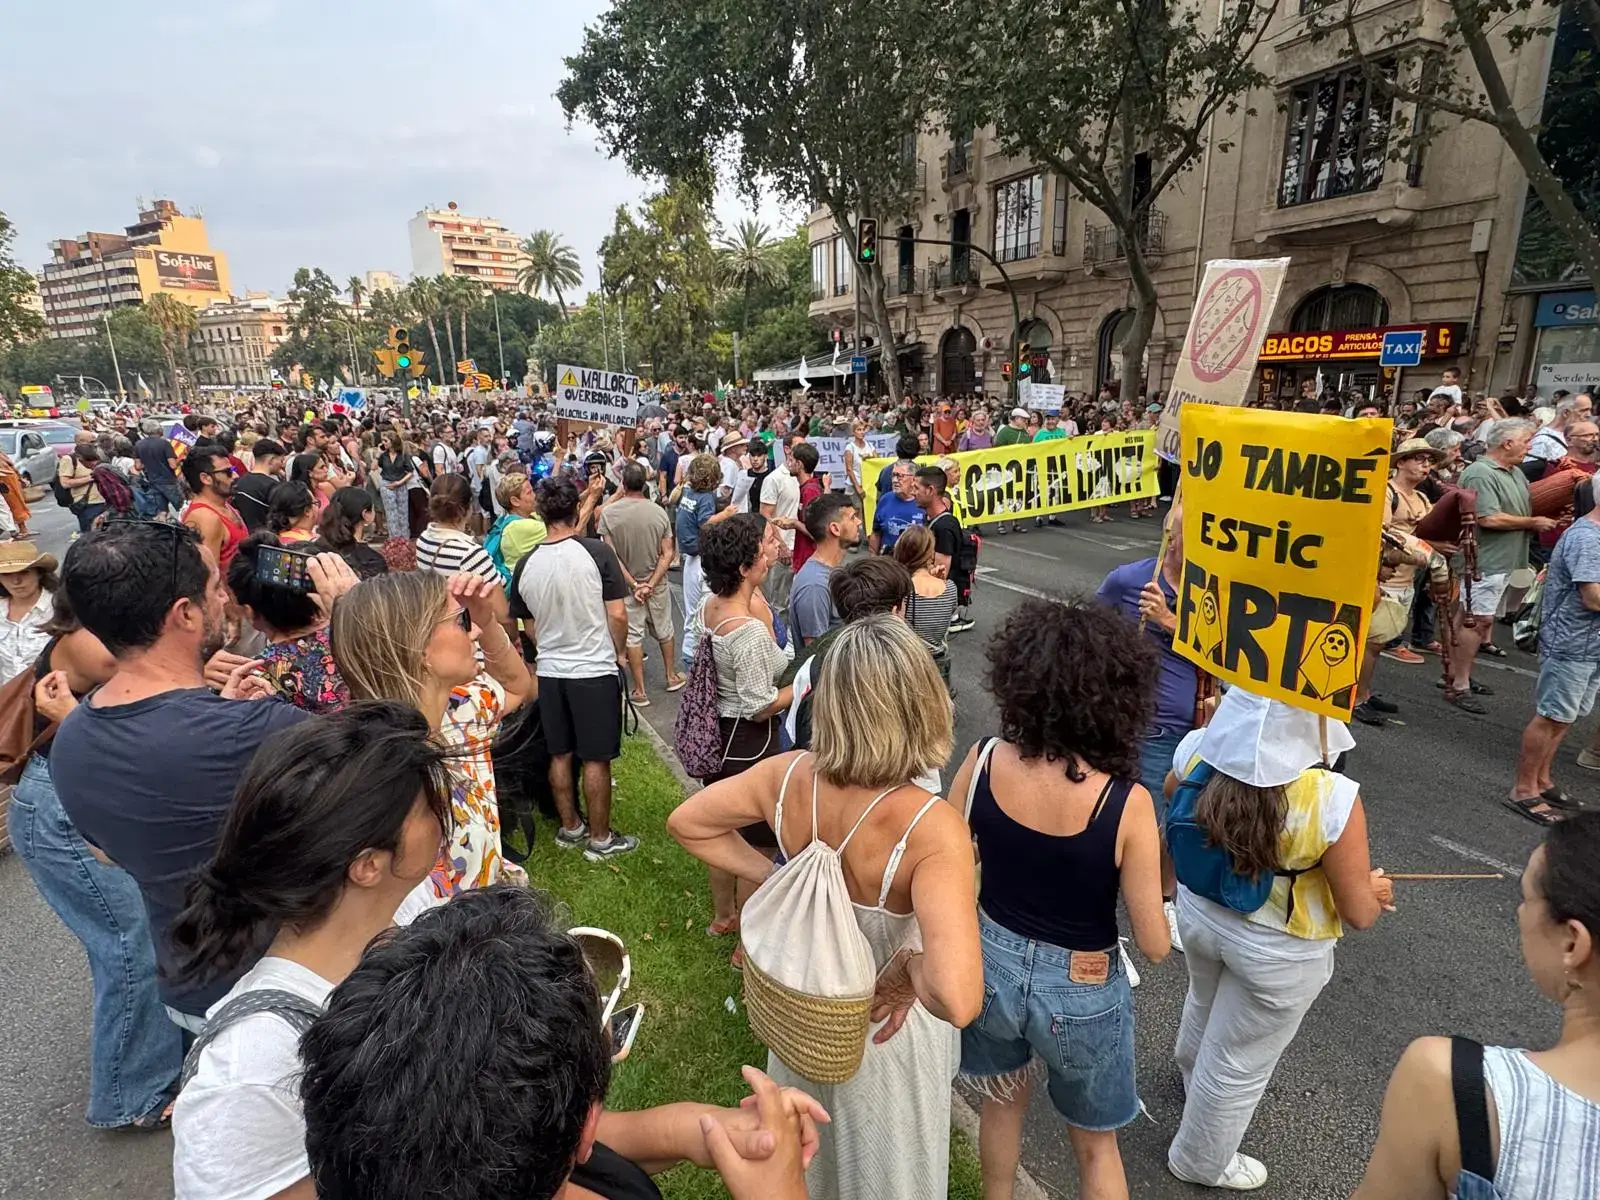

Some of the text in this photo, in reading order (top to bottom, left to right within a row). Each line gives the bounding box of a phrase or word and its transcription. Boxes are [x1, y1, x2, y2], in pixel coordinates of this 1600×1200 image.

[1344, 333, 1377, 341] PRENSA
[1337, 342, 1382, 351] ARTICULOS
[1385, 343, 1419, 354] TAXI
[581, 370, 638, 396] MALLORCA
[1553, 374, 1569, 382] Ser
[1571, 373, 1584, 382] de
[564, 388, 629, 408] OVERBOOKED
[600, 413, 635, 427] MALLORCA
[1187, 437, 1389, 504] JO TAMBÉ
[1046, 454, 1073, 507] AL
